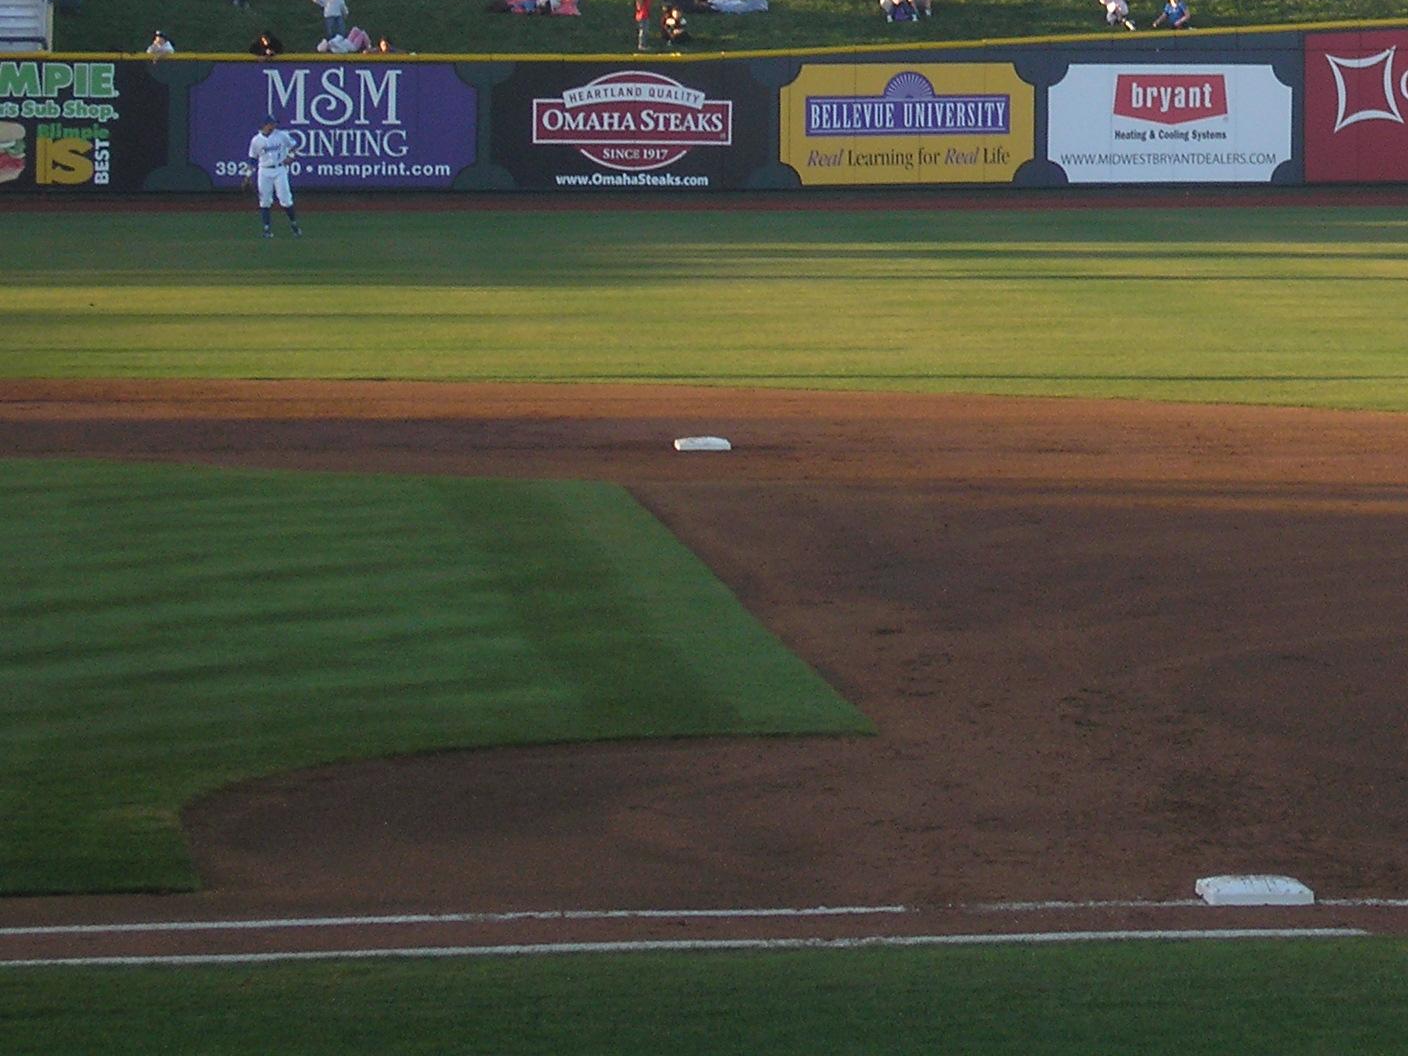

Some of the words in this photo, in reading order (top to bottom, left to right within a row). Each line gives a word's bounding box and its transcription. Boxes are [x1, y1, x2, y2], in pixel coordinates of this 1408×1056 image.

[262, 66, 402, 125] MSM
[569, 86, 643, 103] HEARTLAND
[648, 88, 701, 104] QUALITY
[1131, 82, 1212, 113] bryant
[21, 100, 60, 117] Sub
[811, 103, 895, 129] BELLEVUE
[904, 102, 1006, 128] UNIVERSITY
[542, 109, 635, 131] OMAHA
[640, 110, 723, 132] STEAKS
[37, 122, 110, 140] Blimpie
[1114, 130, 1146, 141] Heating
[1150, 130, 1155, 139] &
[1158, 130, 1189, 141] Cooling
[1191, 130, 1227, 141] Systems
[36, 138, 94, 185] IS
[94, 139, 110, 184] BEST
[603, 148, 640, 159] SINCE
[643, 149, 668, 160] 1917
[807, 149, 844, 167] Real
[848, 147, 914, 170] Learning
[918, 148, 941, 165] for
[944, 147, 979, 165] Real
[983, 146, 1011, 165] Life
[1060, 153, 1277, 165] WWW.MIDWESTBRYANTDEALERS.COM
[318, 162, 450, 178] msmprint.com
[556, 172, 710, 186] www.OmahaSteaks.com
